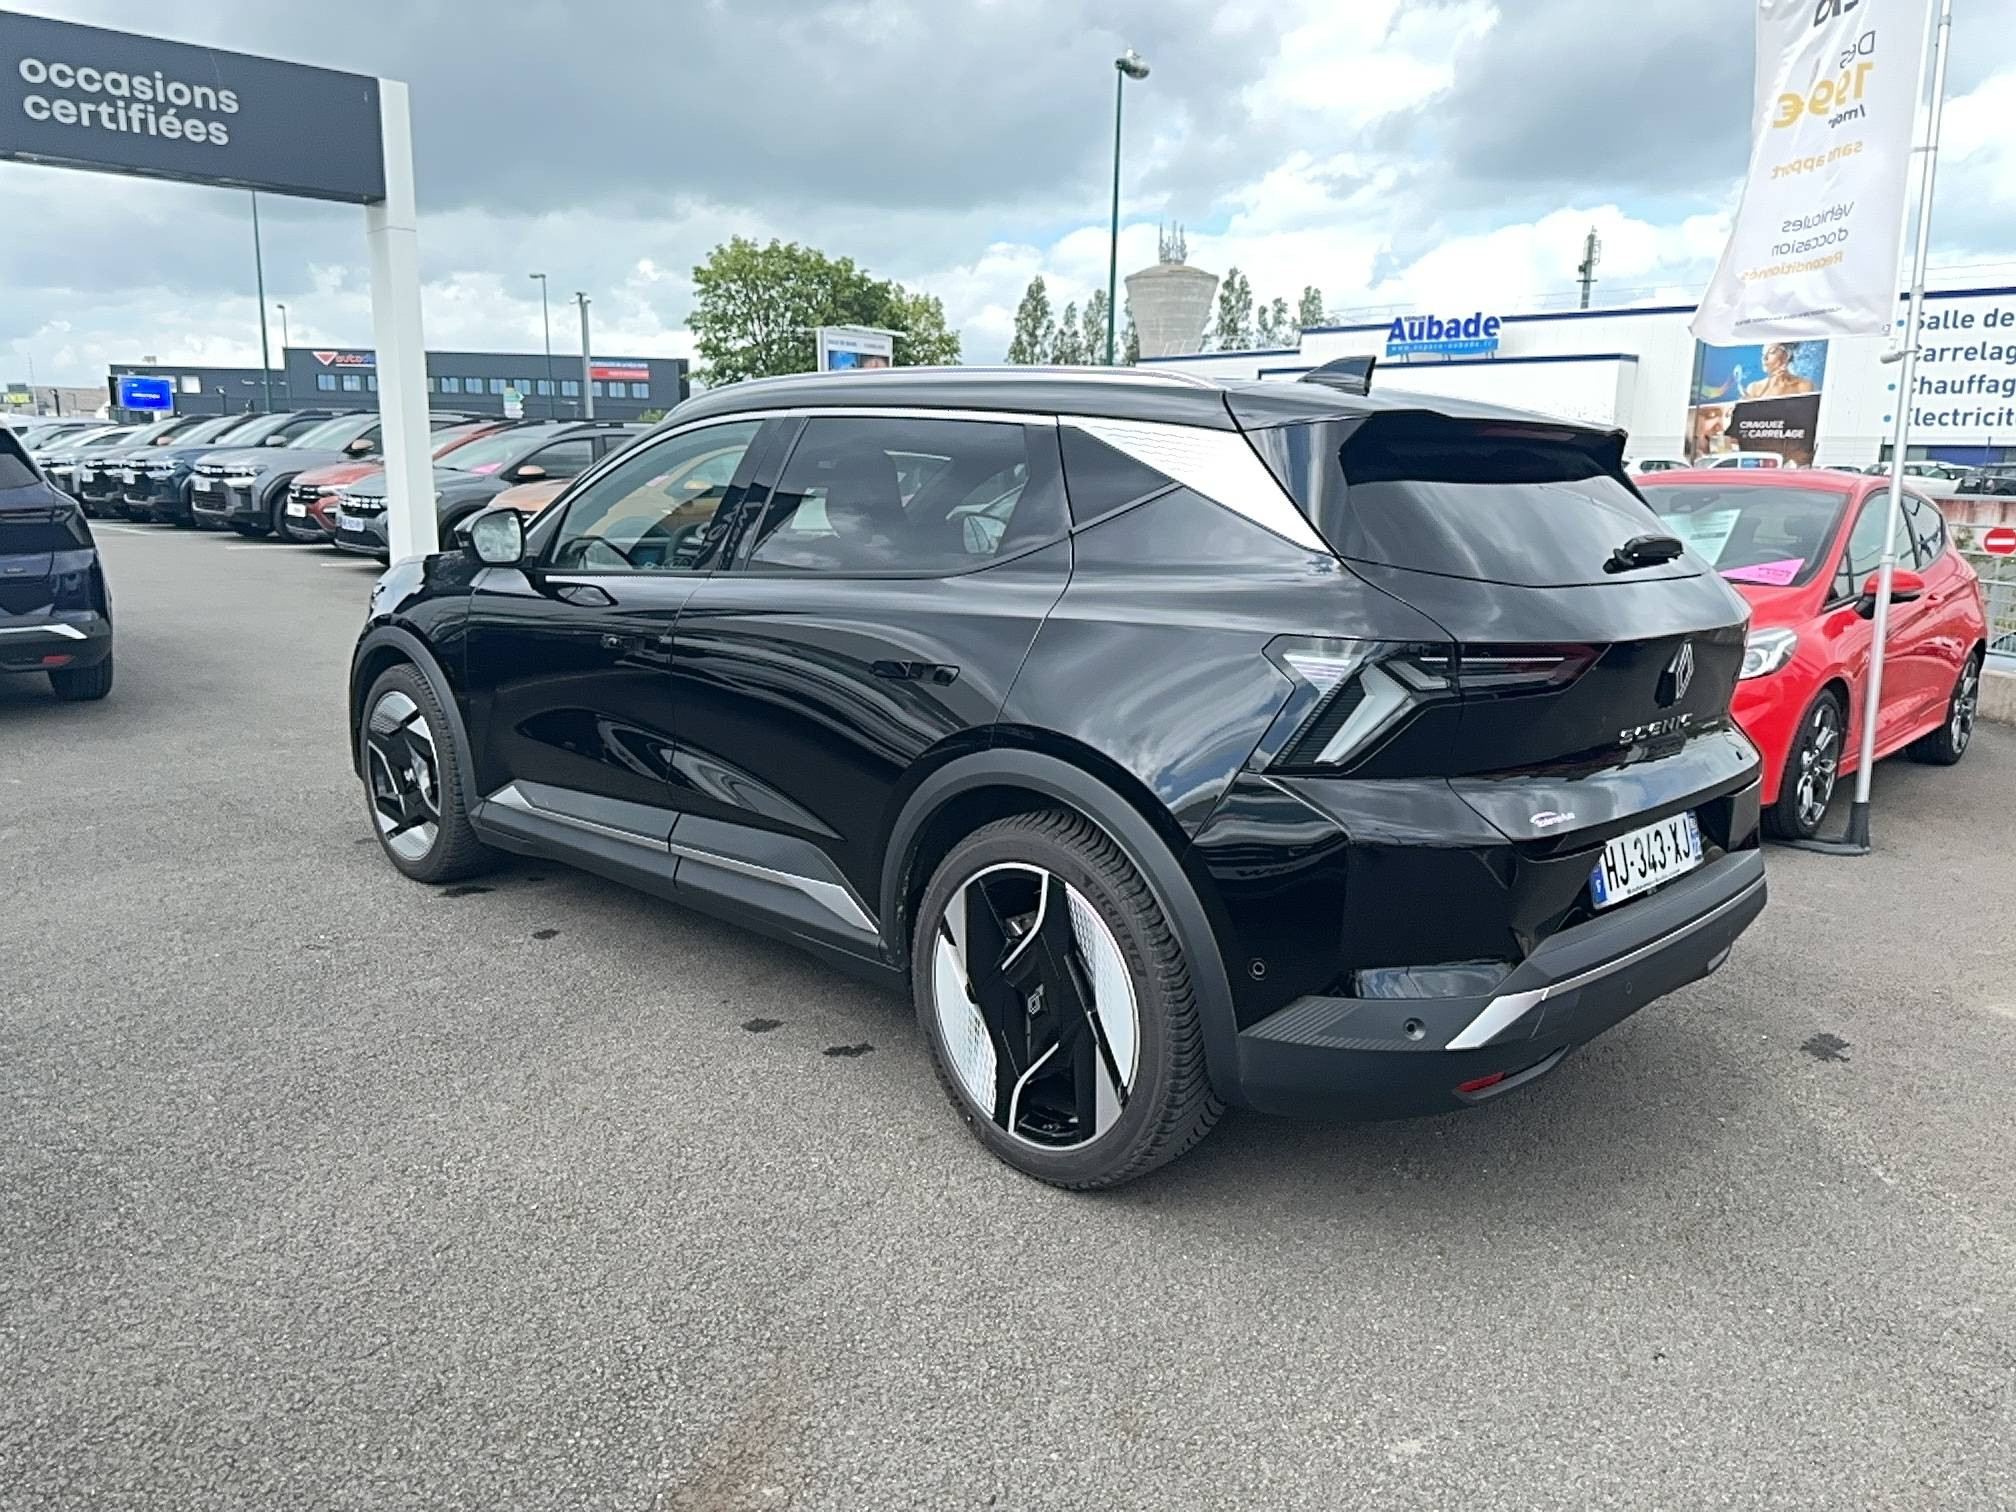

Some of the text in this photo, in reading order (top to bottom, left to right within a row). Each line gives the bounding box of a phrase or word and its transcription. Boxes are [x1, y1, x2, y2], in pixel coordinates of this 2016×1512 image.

[19, 57, 240, 114] occasions
[23, 94, 230, 146] certifiées
[1387, 312, 1500, 342] Aubade
[1982, 307, 2015, 328] de
[1911, 374, 2016, 398] hauffag
[1907, 406, 2016, 427] lectricit
[1748, 429, 1805, 439] CARRELAGE
[1619, 713, 1693, 745] SCENIC
[1603, 819, 1690, 892] HJ-343-XJ
